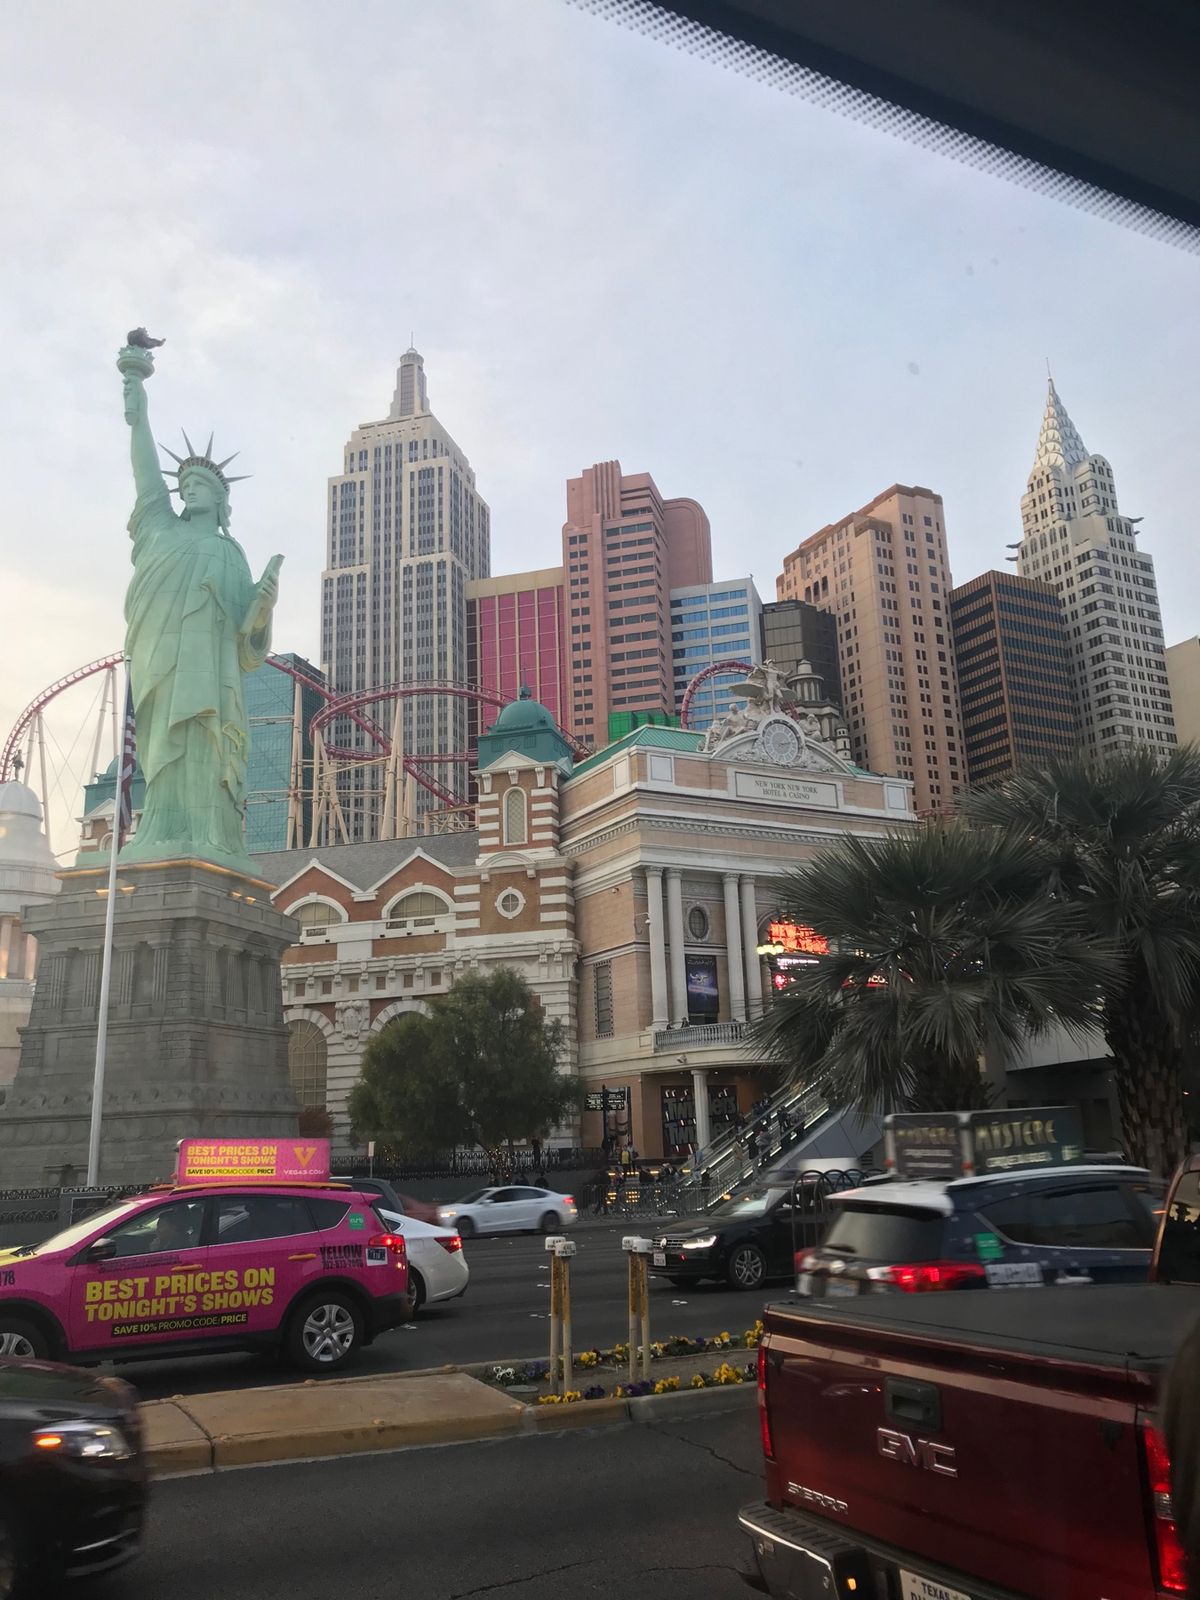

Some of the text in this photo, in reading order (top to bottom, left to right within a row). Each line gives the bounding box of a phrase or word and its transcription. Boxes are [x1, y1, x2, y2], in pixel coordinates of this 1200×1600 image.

[755, 780, 818, 794] NEW YORK NEW YORK
[762, 788, 780, 797] HOTEL
[789, 792, 810, 800] CASINO
[187, 1145, 277, 1156] BEST PRICES ON
[187, 1156, 277, 1165] TONIGHT'S SHOWS
[320, 1245, 362, 1258] YELLOW
[0, 1270, 15, 1286] 78
[86, 1267, 275, 1302] BEST PRICES ON
[85, 1288, 274, 1322] TONIGHT'S SHOWS
[113, 1326, 139, 1335] SAVE
[139, 1323, 157, 1332] 10%
[158, 1319, 192, 1330] PROMO
[220, 1313, 247, 1325] PRICE
[877, 1427, 958, 1478] GMC
[787, 1481, 849, 1516] SIERRA
[921, 1582, 950, 1600] TEXAS
